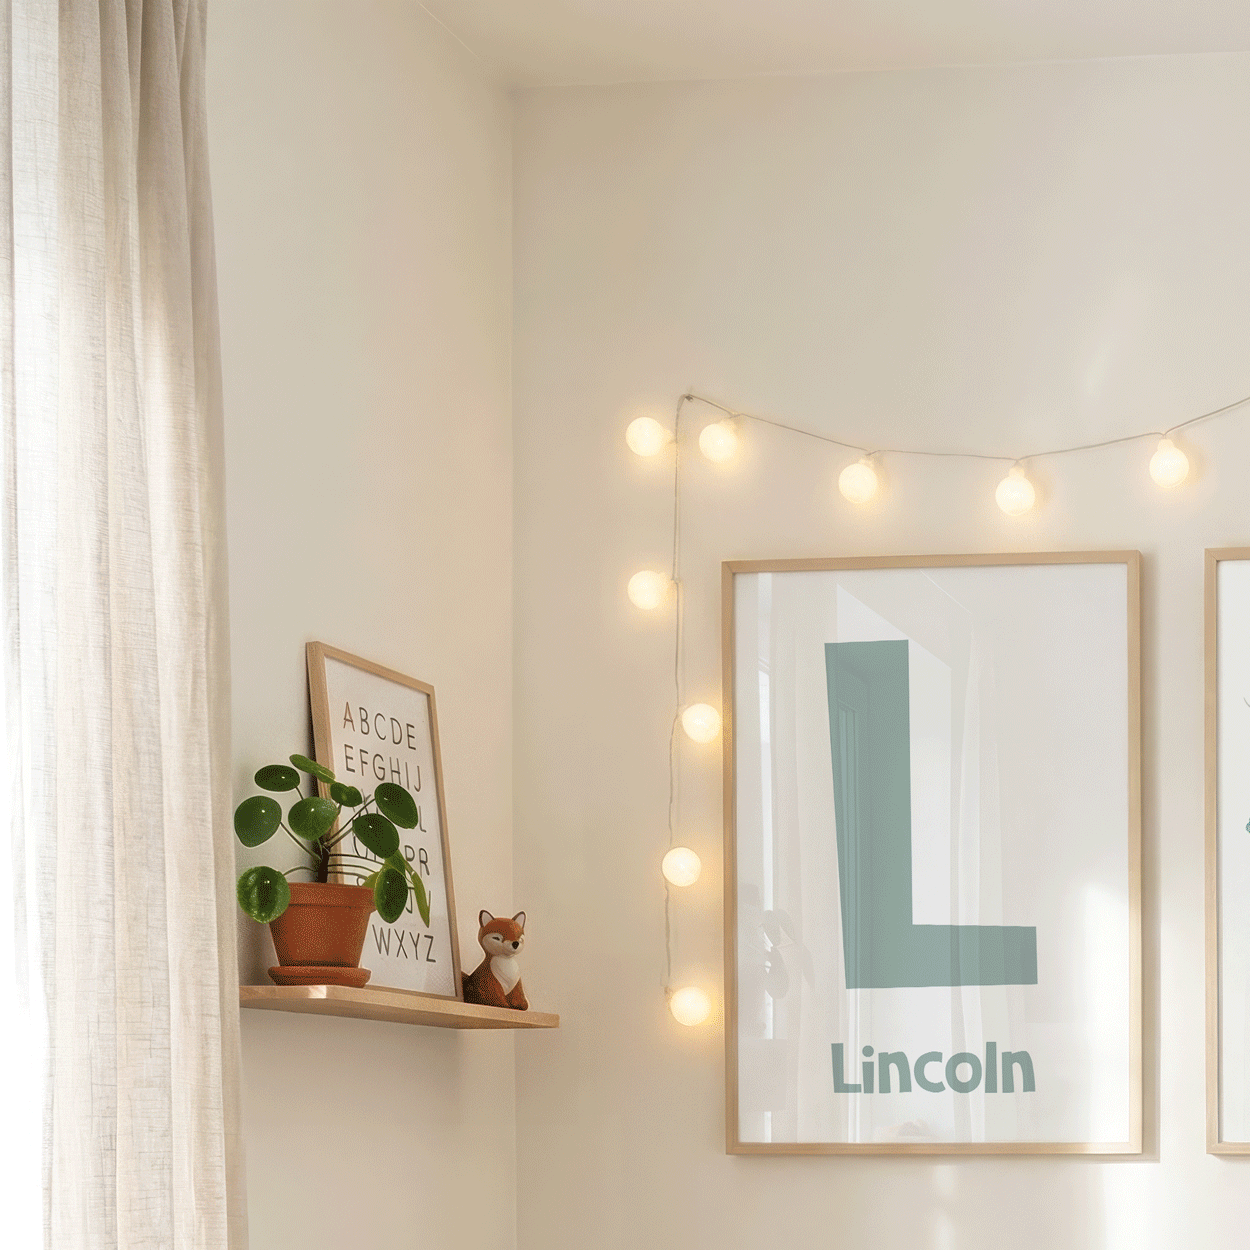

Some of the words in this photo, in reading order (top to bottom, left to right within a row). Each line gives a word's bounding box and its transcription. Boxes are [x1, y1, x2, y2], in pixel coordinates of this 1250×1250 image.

[343, 701, 417, 751] ABCDE
[344, 744, 421, 793] EFGHIJ
[824, 640, 1038, 989] L
[372, 924, 436, 963] WXYZ
[831, 1041, 1036, 1094] Lincoln
